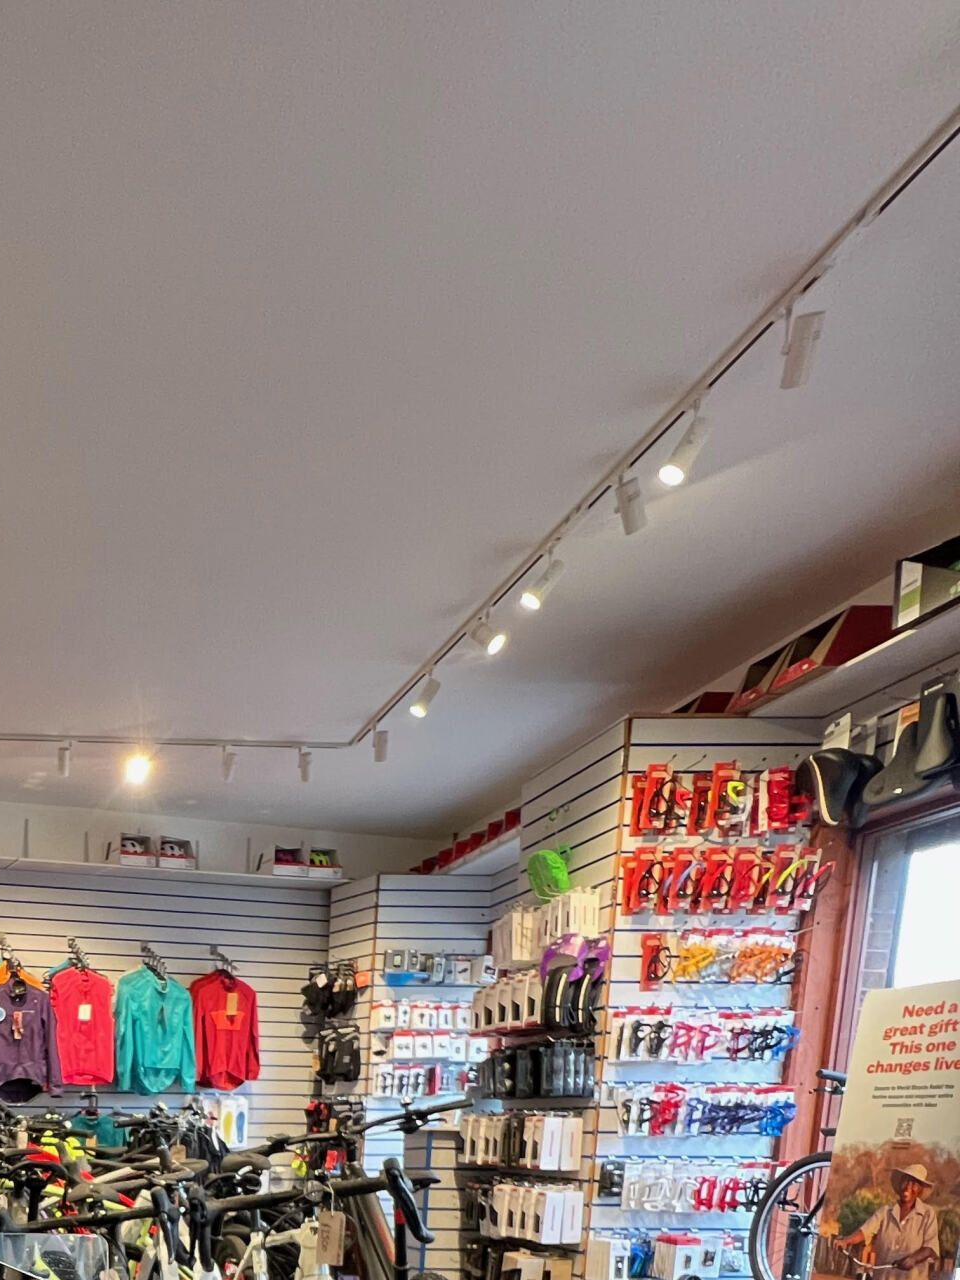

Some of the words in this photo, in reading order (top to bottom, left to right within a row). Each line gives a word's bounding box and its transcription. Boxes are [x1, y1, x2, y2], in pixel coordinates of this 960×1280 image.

[902, 1000, 945, 1018] Need
[948, 1002, 958, 1014] a
[883, 1023, 926, 1041] great
[928, 1019, 960, 1037] gift
[889, 1040, 922, 1055] This
[926, 1041, 956, 1053] one
[867, 1060, 930, 1075] changes
